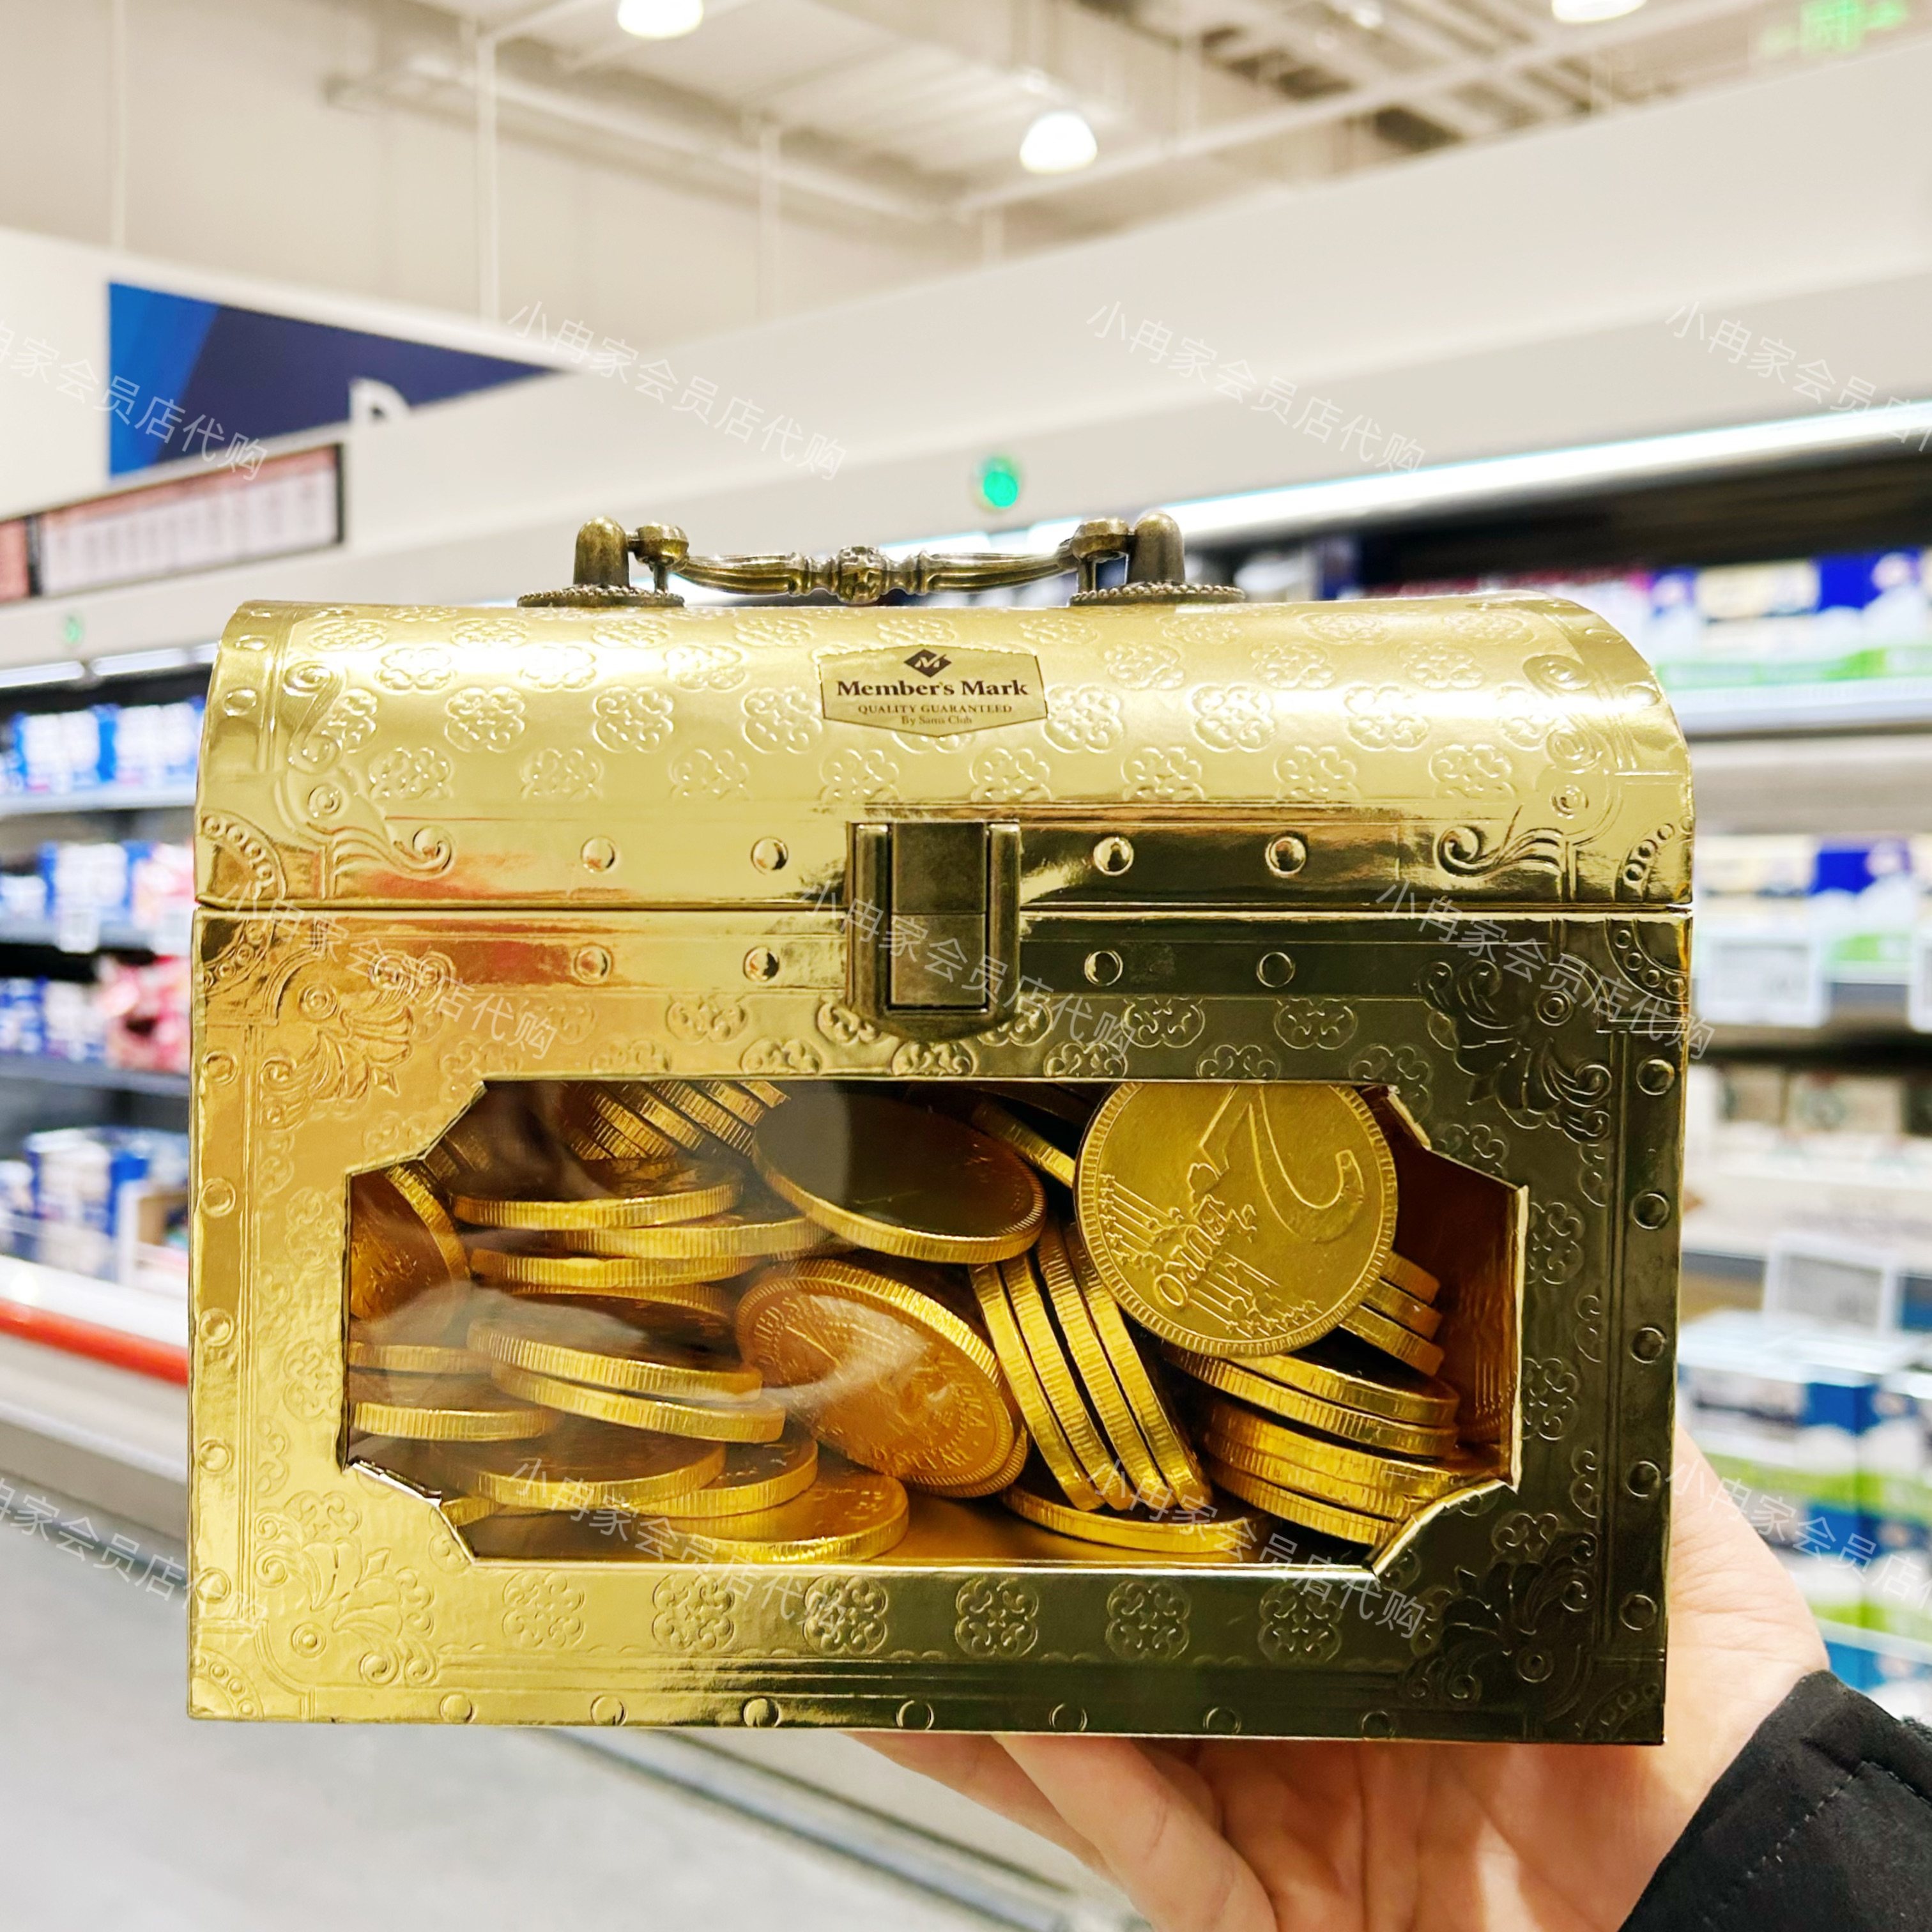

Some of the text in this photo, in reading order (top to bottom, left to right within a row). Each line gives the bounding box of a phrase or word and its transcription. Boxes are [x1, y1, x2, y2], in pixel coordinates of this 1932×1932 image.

[837, 679, 1029, 696] Member's Mark
[858, 704, 1012, 714] QUALITY GUARANTEED
[901, 716, 916, 726] By
[948, 715, 972, 724] Club
[1154, 1194, 1227, 1309] EURO
